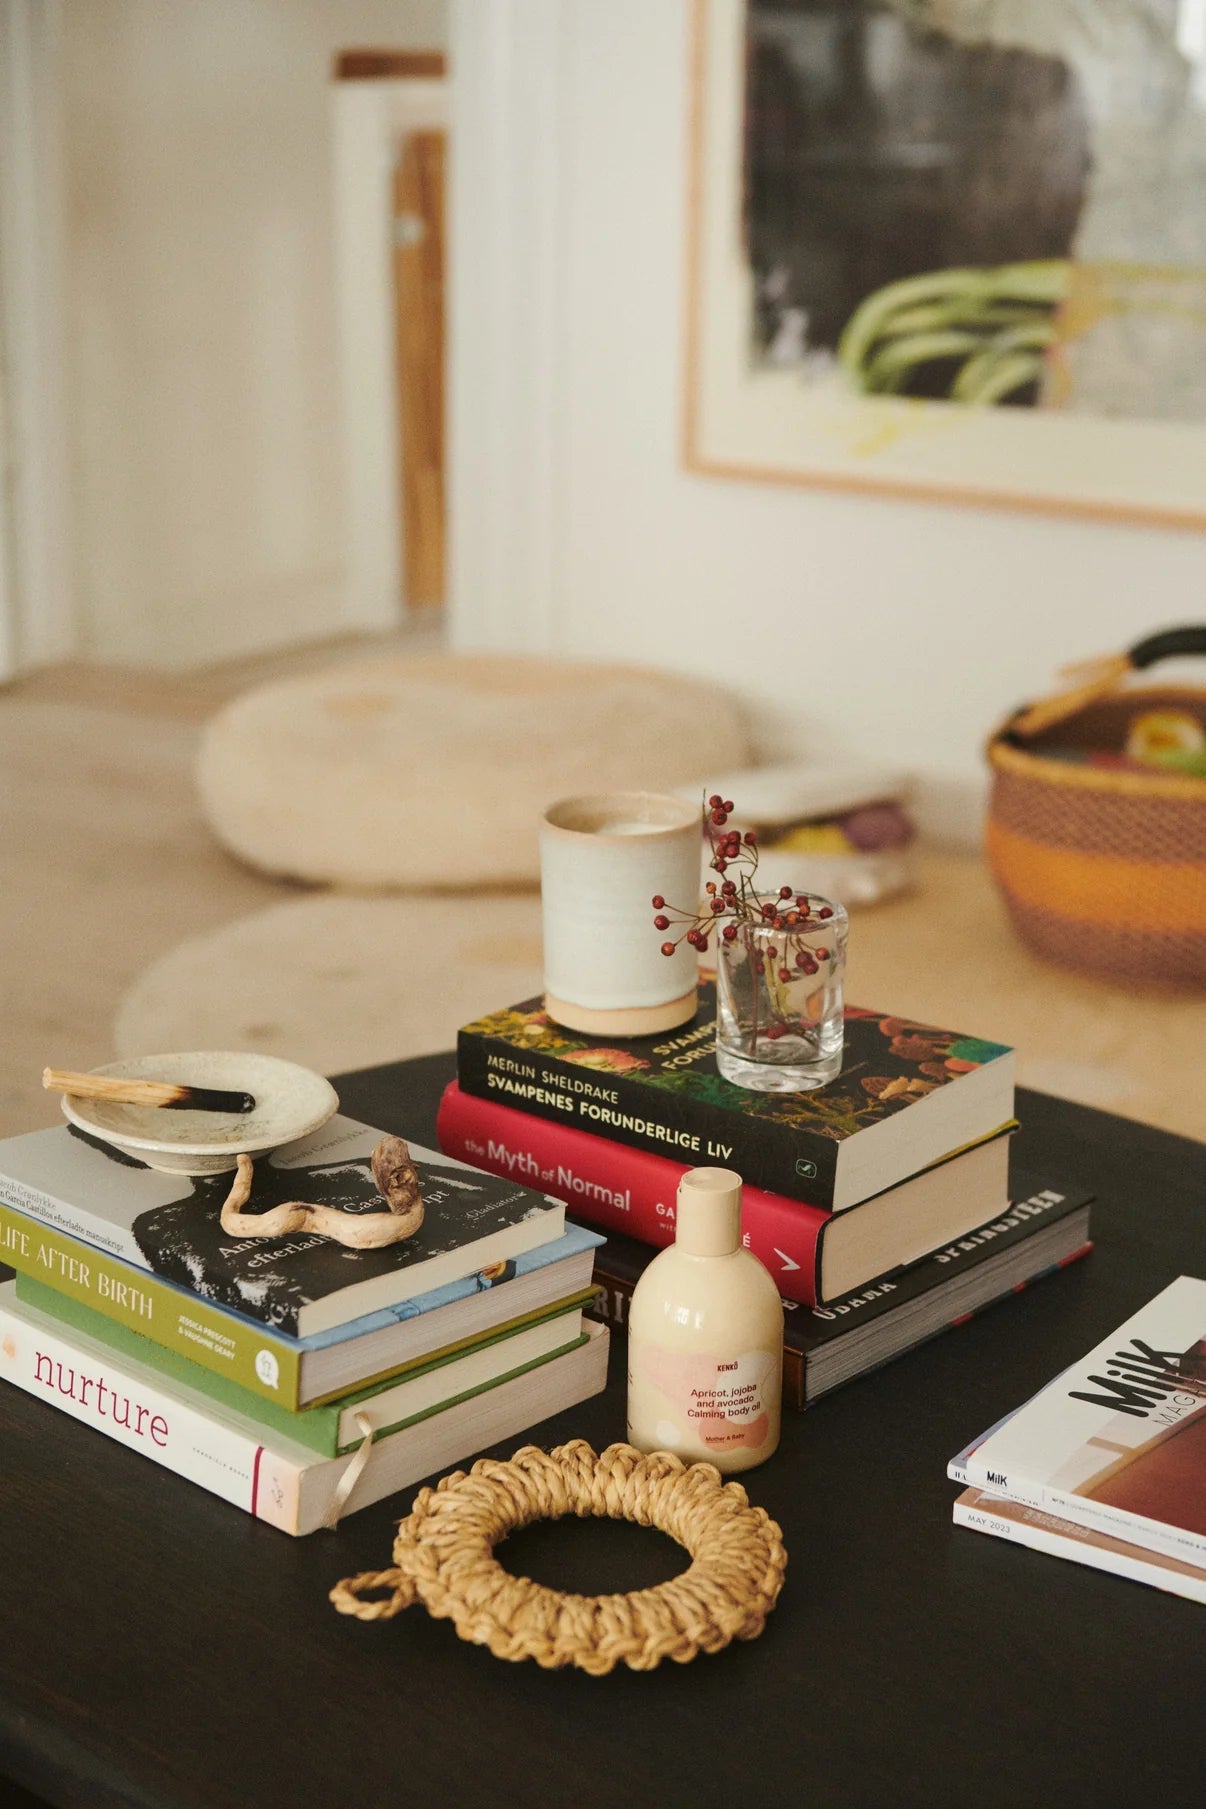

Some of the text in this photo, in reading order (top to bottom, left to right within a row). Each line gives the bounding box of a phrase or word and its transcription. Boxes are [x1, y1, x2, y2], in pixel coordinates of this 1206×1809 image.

[487, 1055, 619, 1105] MERLIN SHELDRAKE
[486, 1073, 733, 1161] SVAMPENES FORUNDERLIGE LIV
[464, 1139, 485, 1157] the
[487, 1140, 539, 1179] Myth
[556, 1164, 631, 1212] Normal
[0, 1222, 153, 1320] LIFE AFTER BIRTH
[34, 1351, 169, 1447] nurture
[687, 1401, 761, 1420] Calming body oil
[690, 1384, 757, 1399] Apricot, jojoba
[696, 1395, 755, 1408] and avocado
[967, 1514, 987, 1526] MAY
[990, 1520, 1011, 1534] 2023
